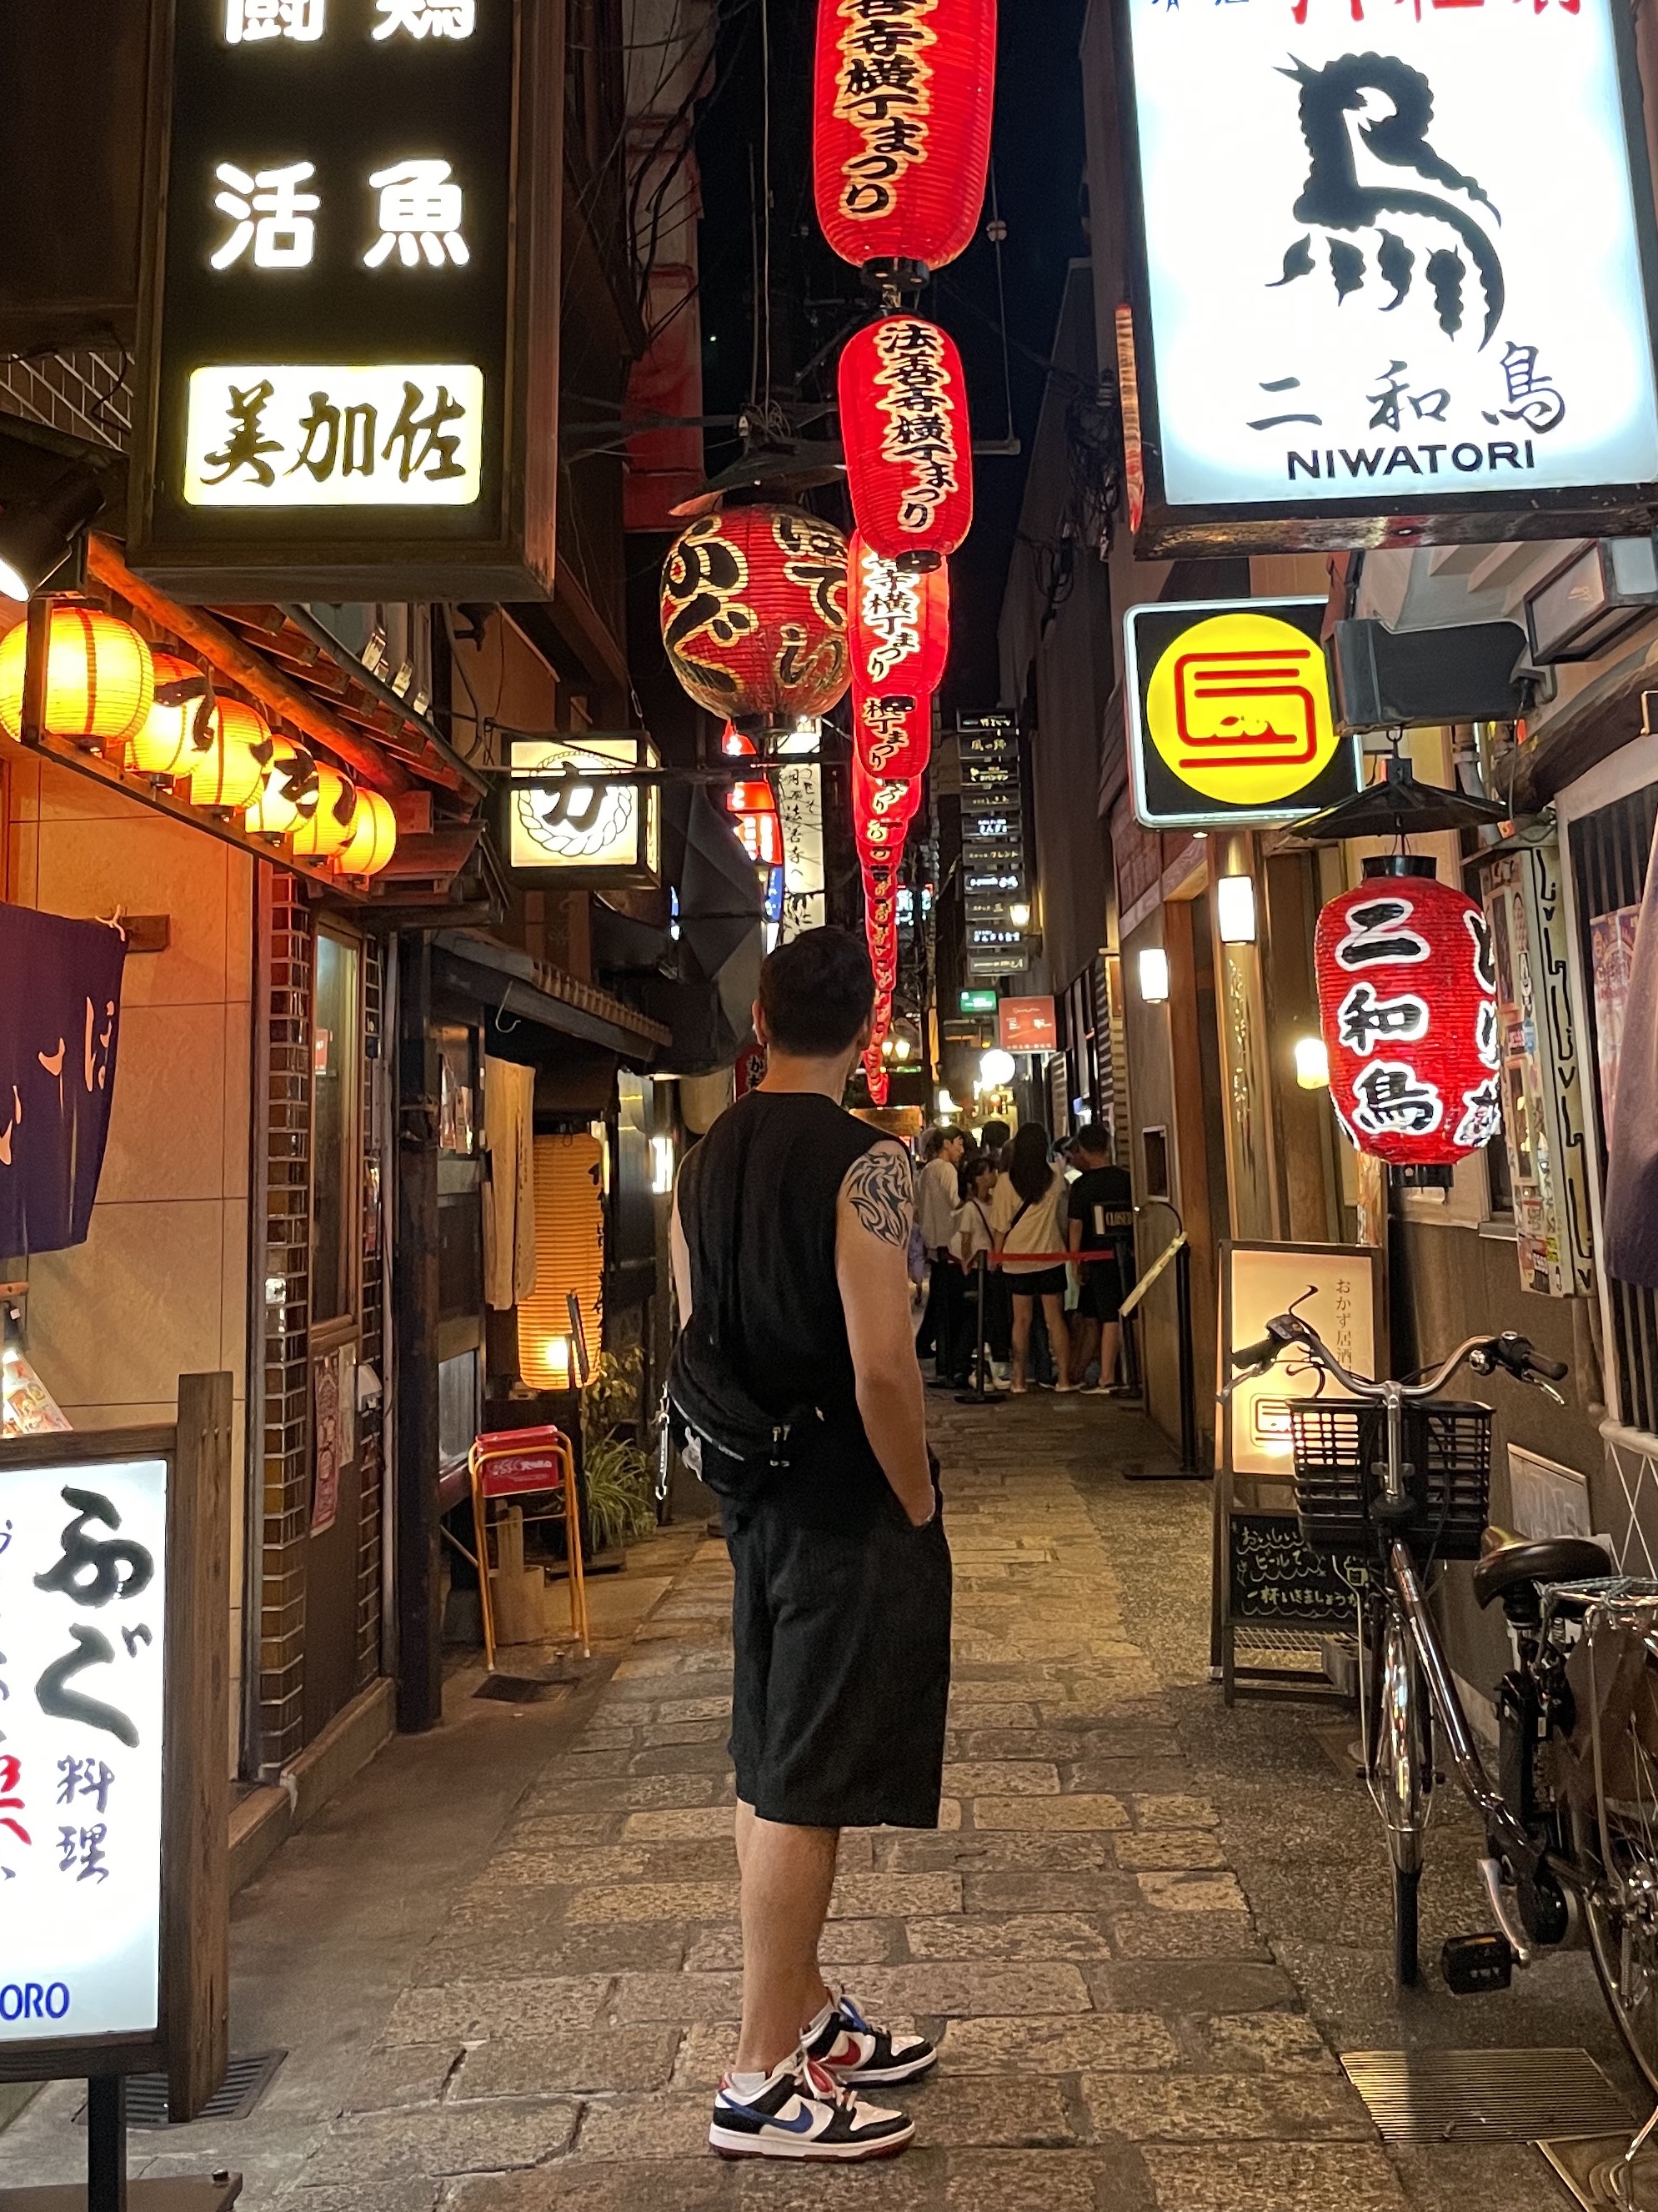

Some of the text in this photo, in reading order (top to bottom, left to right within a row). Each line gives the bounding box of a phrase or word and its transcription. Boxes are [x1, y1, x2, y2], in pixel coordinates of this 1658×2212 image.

[210, 159, 471, 269] 活魚
[200, 379, 467, 488] 美加佐
[880, 324, 954, 528] 法善寺横丁まつり
[1246, 340, 1565, 434] 二和鳥
[1287, 439, 1535, 481] NIWATORI
[868, 559, 916, 677] 寺横丁まつり
[1340, 902, 1441, 1131] 二和鳥
[1335, 1278, 1352, 1373] おかず居酒
